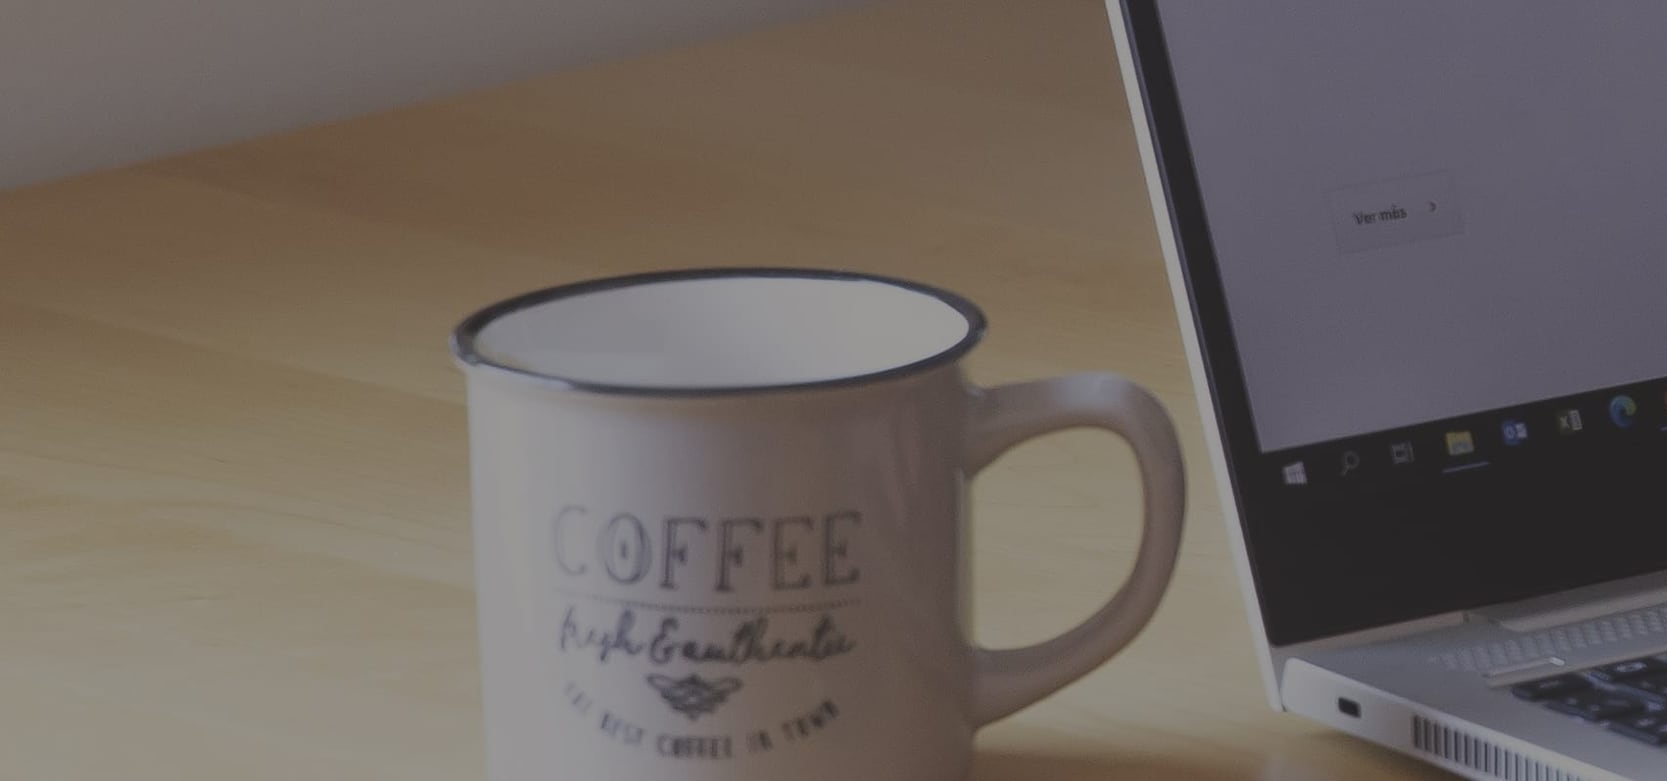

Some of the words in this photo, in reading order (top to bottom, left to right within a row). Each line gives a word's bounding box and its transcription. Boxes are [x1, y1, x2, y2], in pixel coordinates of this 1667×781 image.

[1353, 212, 1376, 225] Ver
[1379, 203, 1407, 221] más
[554, 504, 864, 592] COFFEE
[559, 604, 645, 662] fresh
[656, 734, 733, 760] COFFEE
